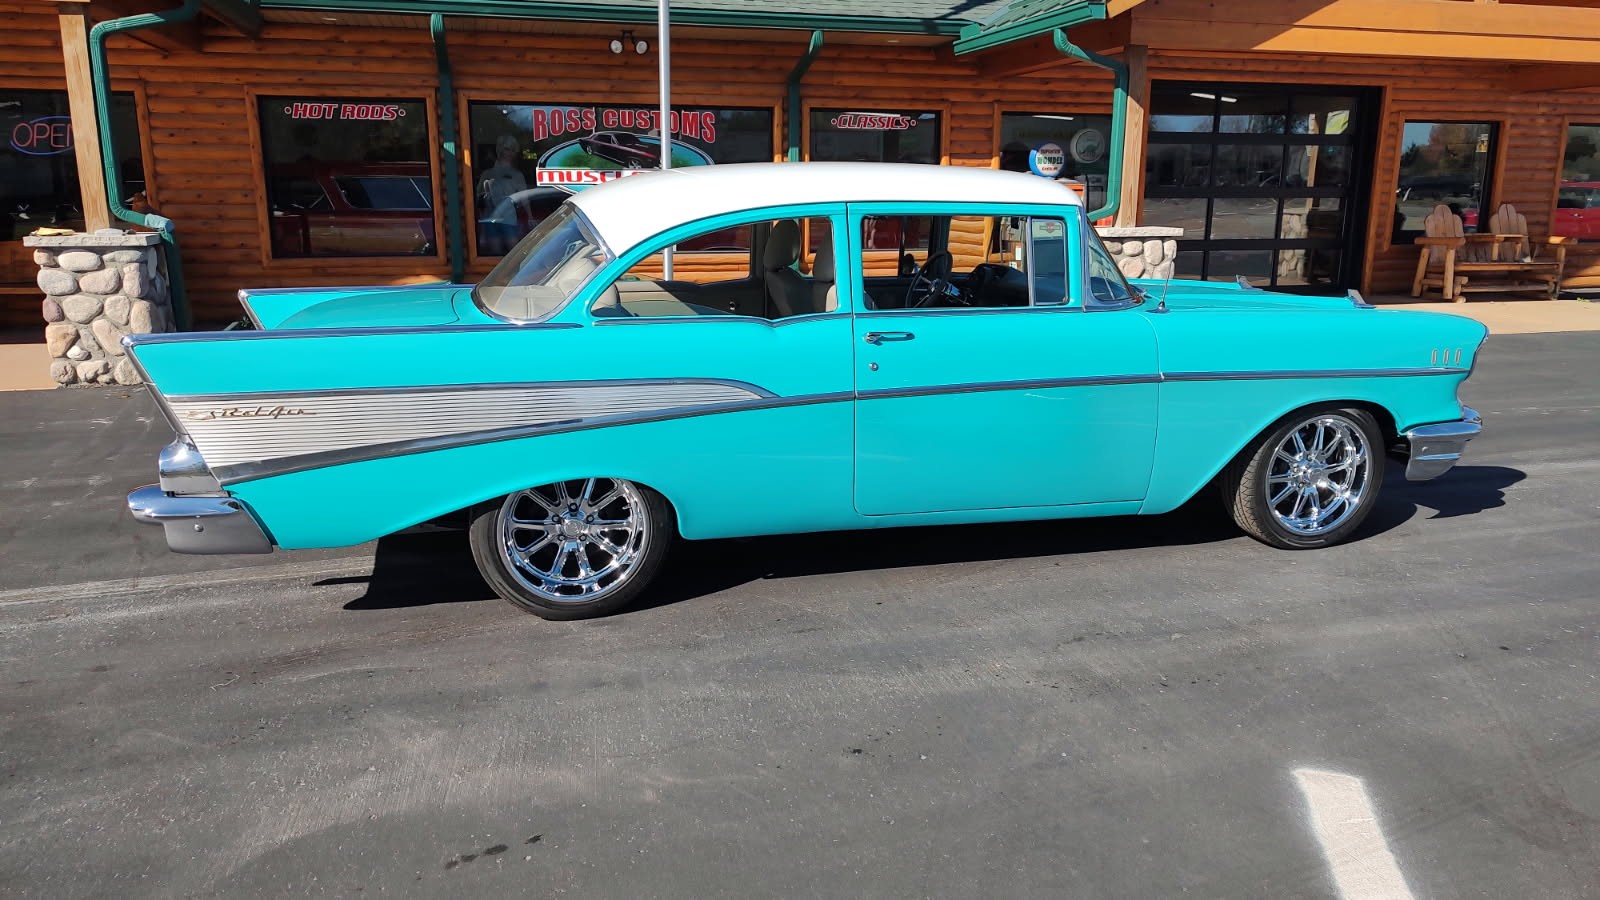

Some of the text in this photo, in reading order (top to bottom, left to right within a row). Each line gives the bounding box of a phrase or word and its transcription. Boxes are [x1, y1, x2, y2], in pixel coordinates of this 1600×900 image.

[292, 103, 399, 120] HOT RODS
[533, 109, 715, 143] ROSS CUSTOMS
[837, 114, 911, 129] CLASSICS
